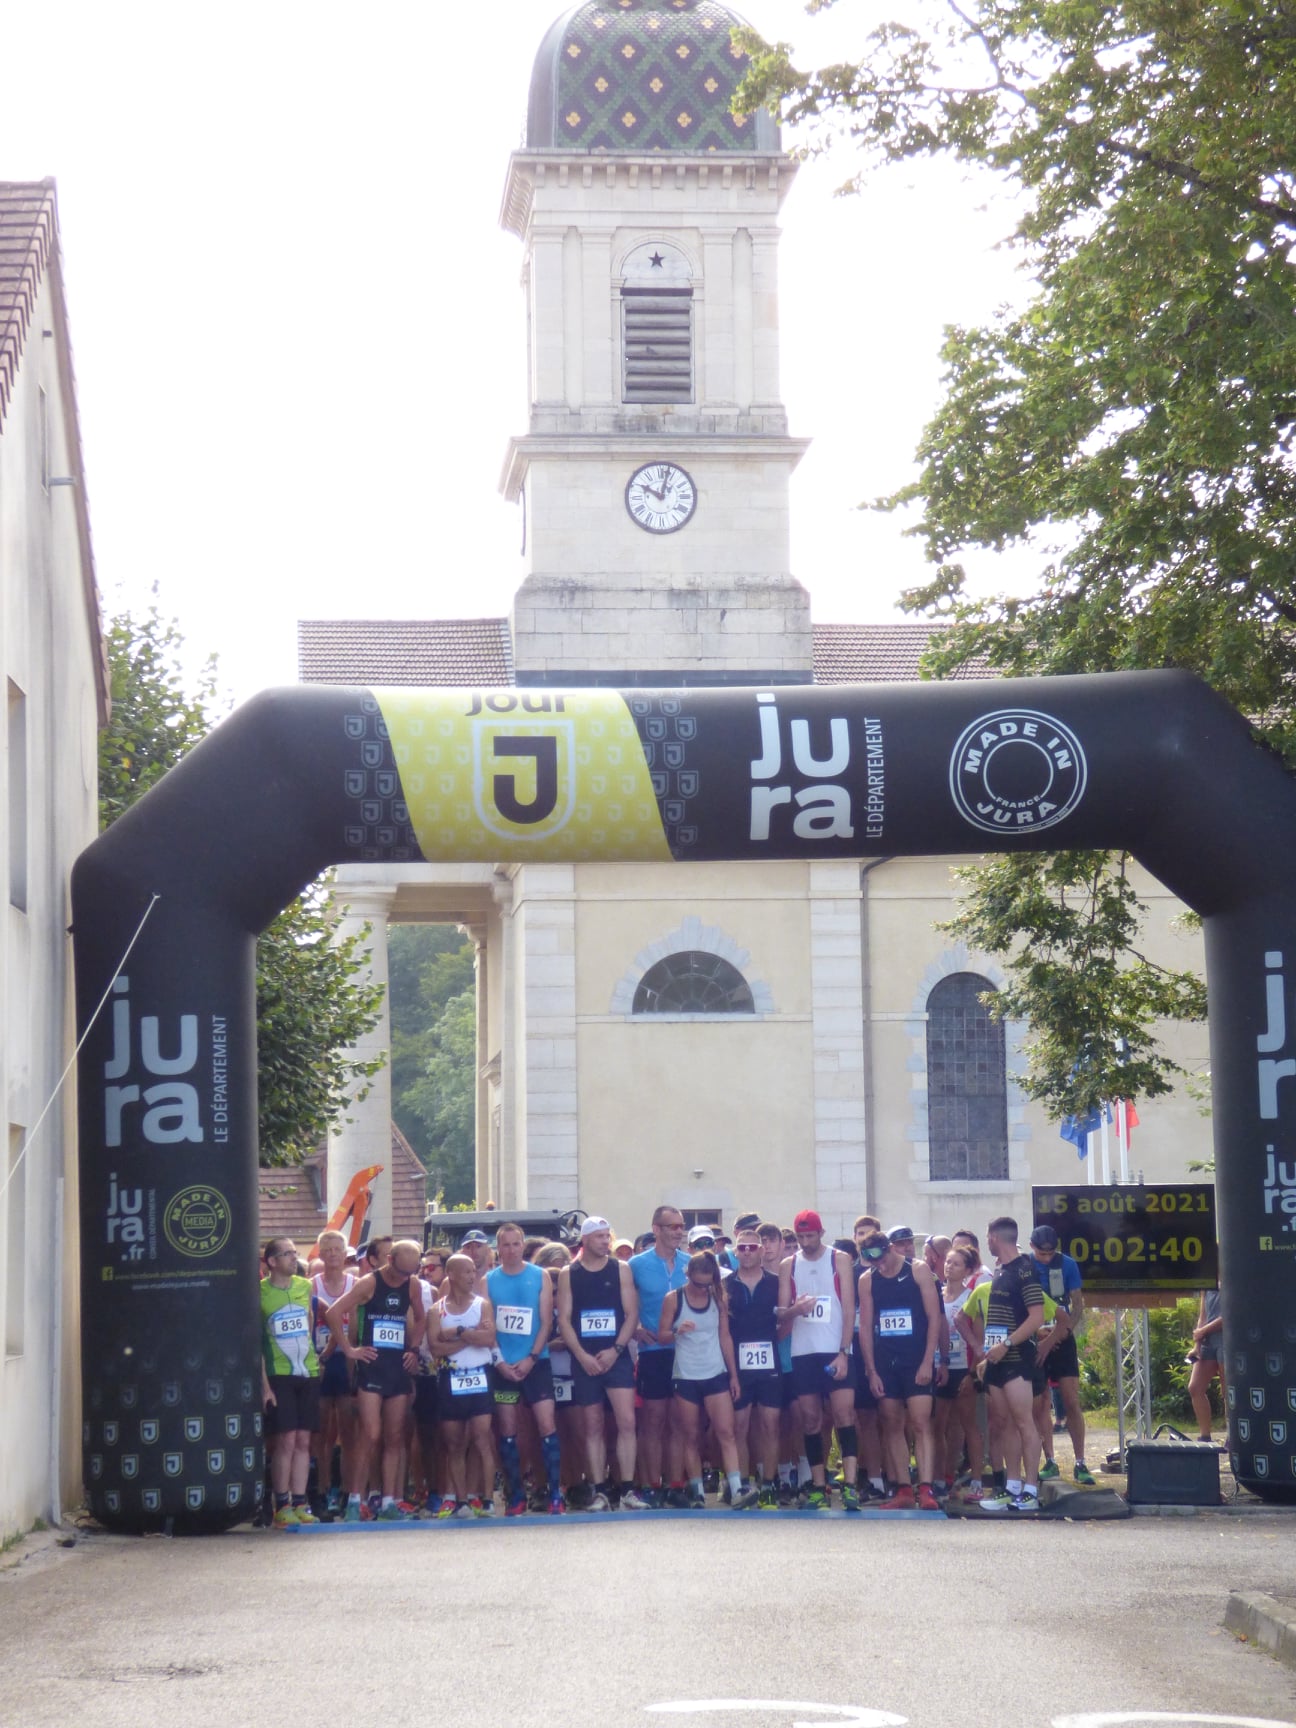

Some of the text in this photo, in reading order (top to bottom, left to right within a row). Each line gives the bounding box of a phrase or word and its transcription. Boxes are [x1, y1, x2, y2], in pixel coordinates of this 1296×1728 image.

[964, 721, 1073, 774] MADE IN
[493, 736, 558, 824] J
[864, 717, 884, 838] LE DÉPARTEMENT
[995, 795, 1041, 808] FRANCE
[976, 799, 1057, 825] JURA
[211, 1014, 228, 1143] LE DÉPARTEMENT
[171, 1193, 225, 1220] MADE IN
[1037, 1192, 1210, 1214] 15 août 2021
[185, 1216, 214, 1226] MEDIA
[178, 1235, 219, 1250] JURA
[121, 1244, 145, 1261] .fr
[803, 1304, 823, 1318] 10
[281, 1318, 302, 1332] 836
[504, 1314, 524, 1330] 172
[587, 1318, 609, 1329] 767
[885, 1317, 906, 1329] 812
[379, 1329, 400, 1342] 801
[746, 1350, 767, 1365] 215
[457, 1376, 481, 1388] 793
